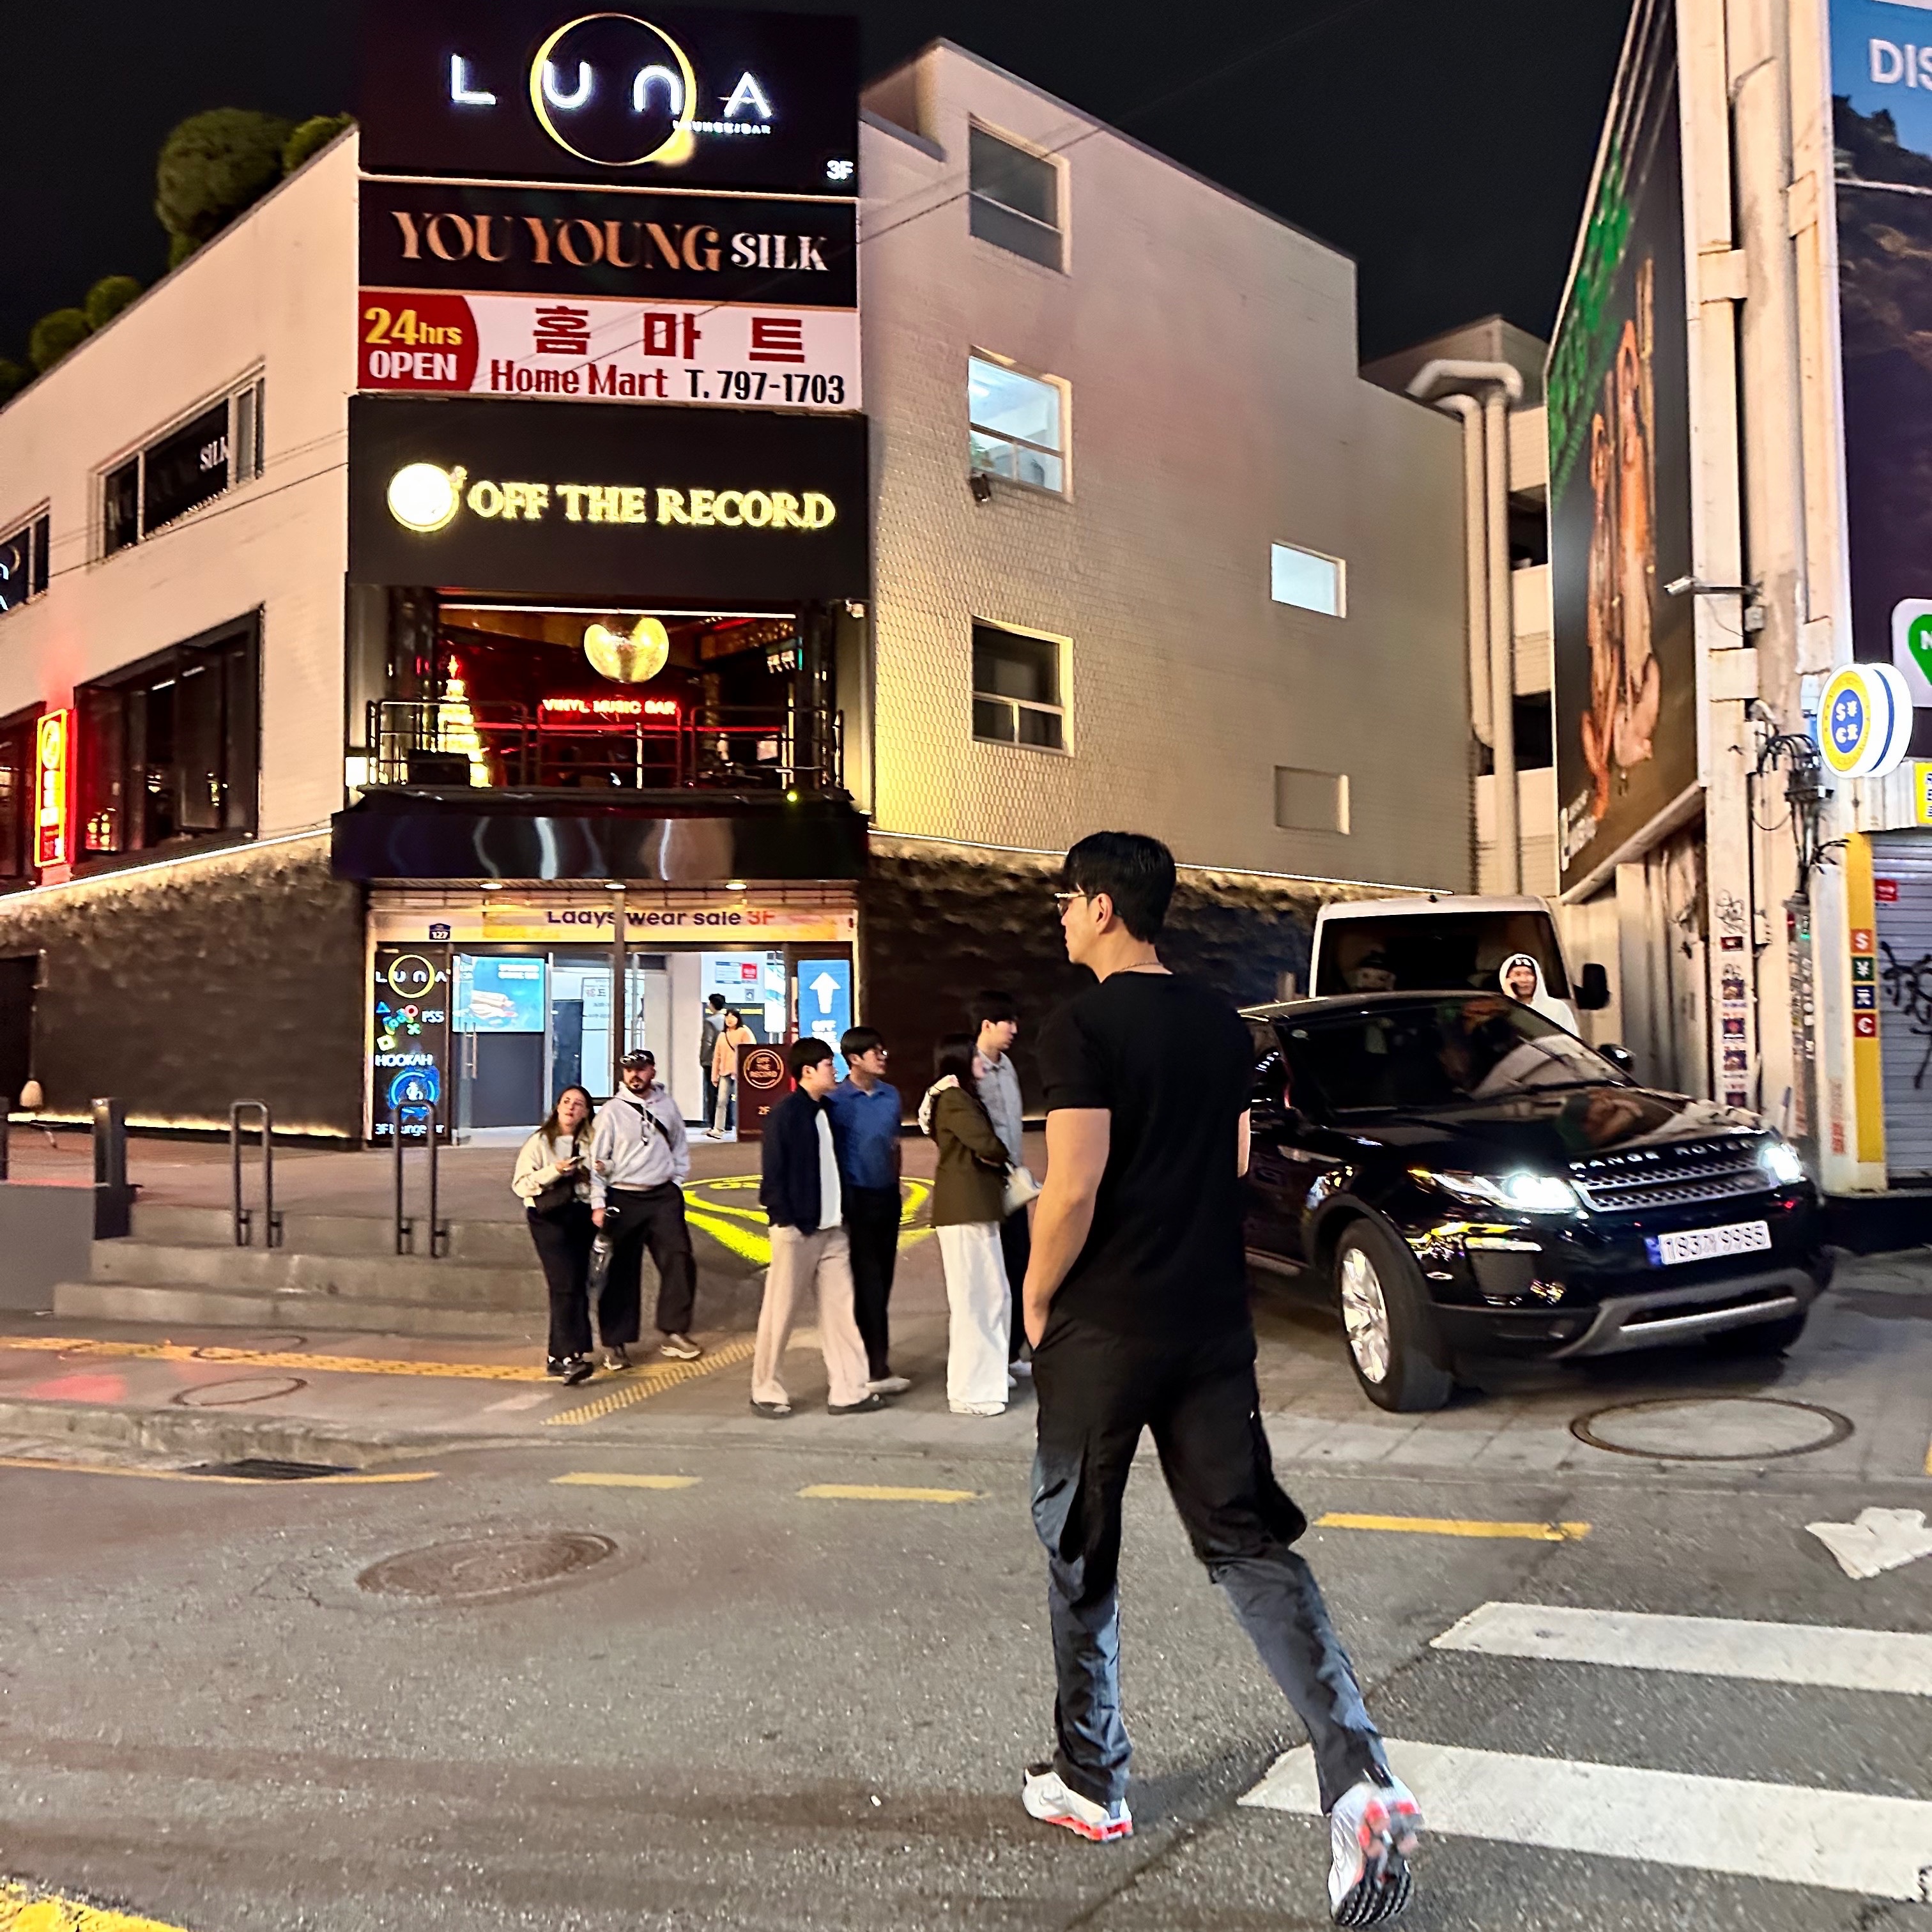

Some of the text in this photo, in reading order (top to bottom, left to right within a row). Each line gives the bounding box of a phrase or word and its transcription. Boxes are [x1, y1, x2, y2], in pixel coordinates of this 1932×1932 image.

[826, 160, 854, 180] 3F
[389, 211, 830, 272] YOU YOUNG SILK
[364, 307, 463, 346] 24hrs
[369, 349, 457, 381] OPEN
[491, 359, 845, 404] Home Mart T. 797-1703
[468, 480, 836, 530] OFF THE RECORD
[542, 698, 676, 714] VINYL MUSIC BAR
[628, 912, 687, 926] wear
[693, 910, 742, 926] sale
[432, 931, 448, 939] 127
[375, 1054, 433, 1066] HOOKAH
